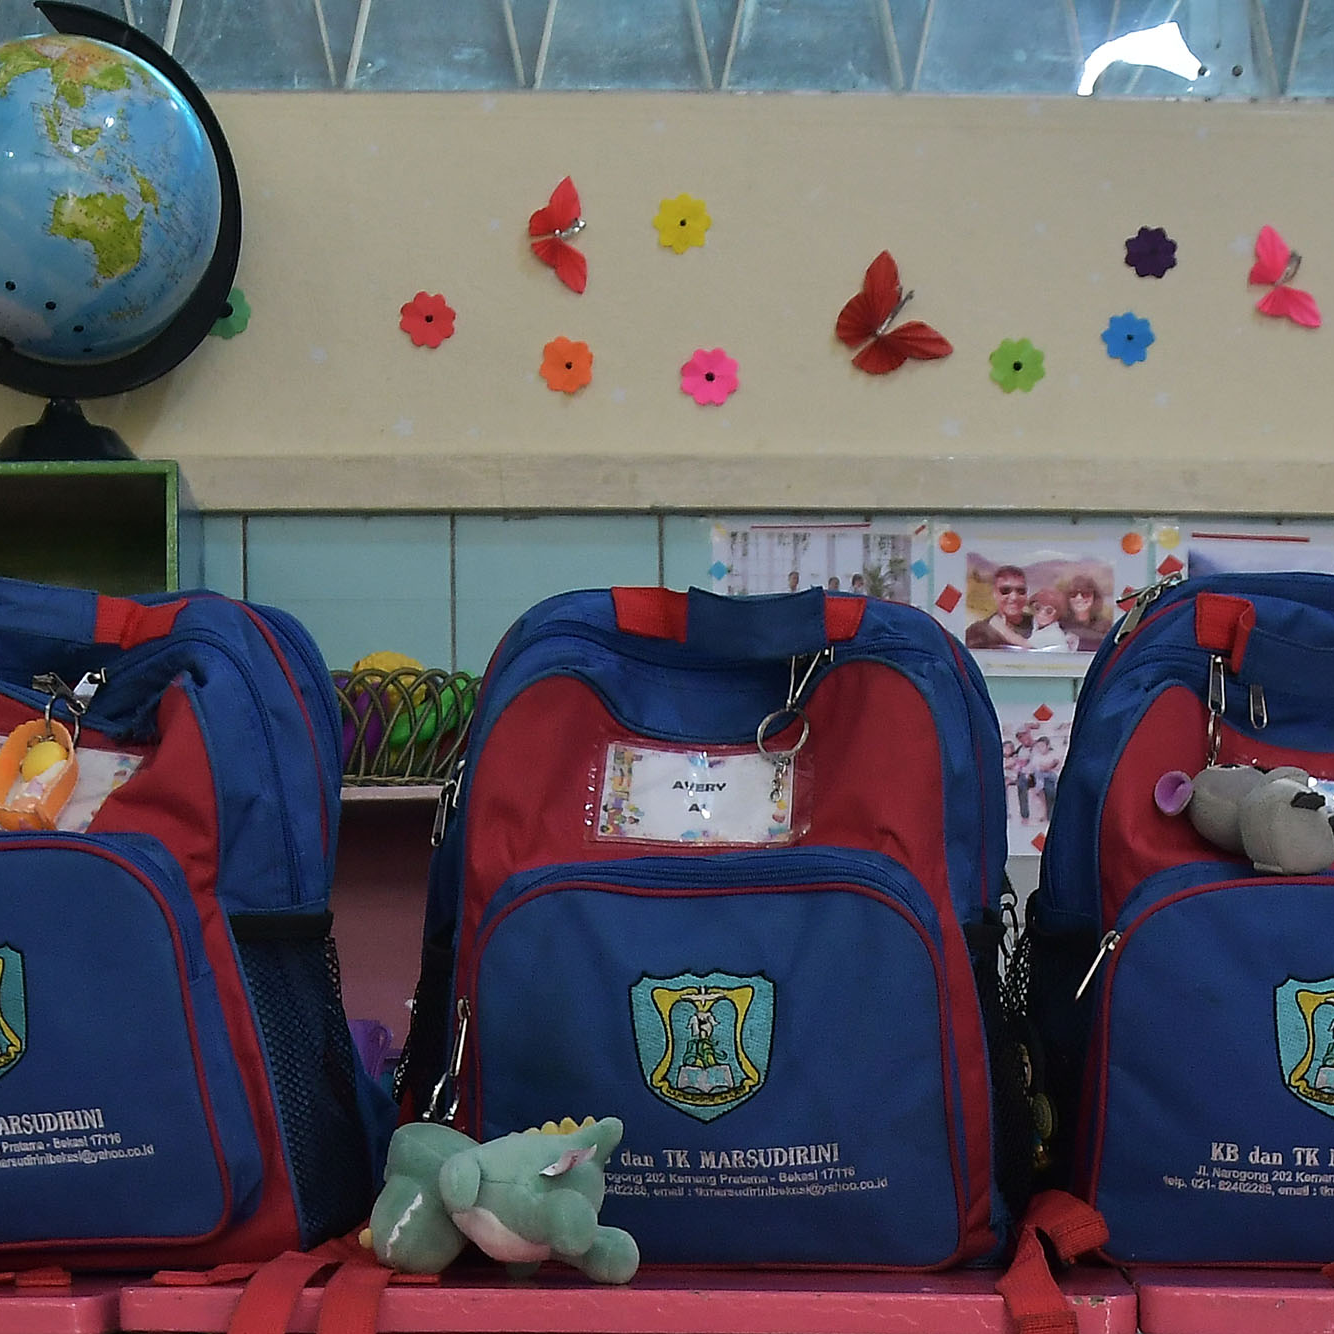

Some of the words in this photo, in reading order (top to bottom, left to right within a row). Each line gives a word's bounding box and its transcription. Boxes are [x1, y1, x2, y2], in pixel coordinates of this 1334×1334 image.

[672, 781, 727, 792] AVERY
[621, 1148, 654, 1168] dan
[662, 1149, 691, 1168] TK
[700, 1142, 840, 1169] MARSUDIRINI
[1210, 1142, 1239, 1162] KB
[1248, 1145, 1283, 1165] dan
[1292, 1147, 1320, 1167] TK
[603, 1172, 643, 1185] rogong
[645, 1172, 666, 1183] 202
[1212, 1167, 1269, 1183] Narogong
[1272, 1170, 1293, 1182] 202
